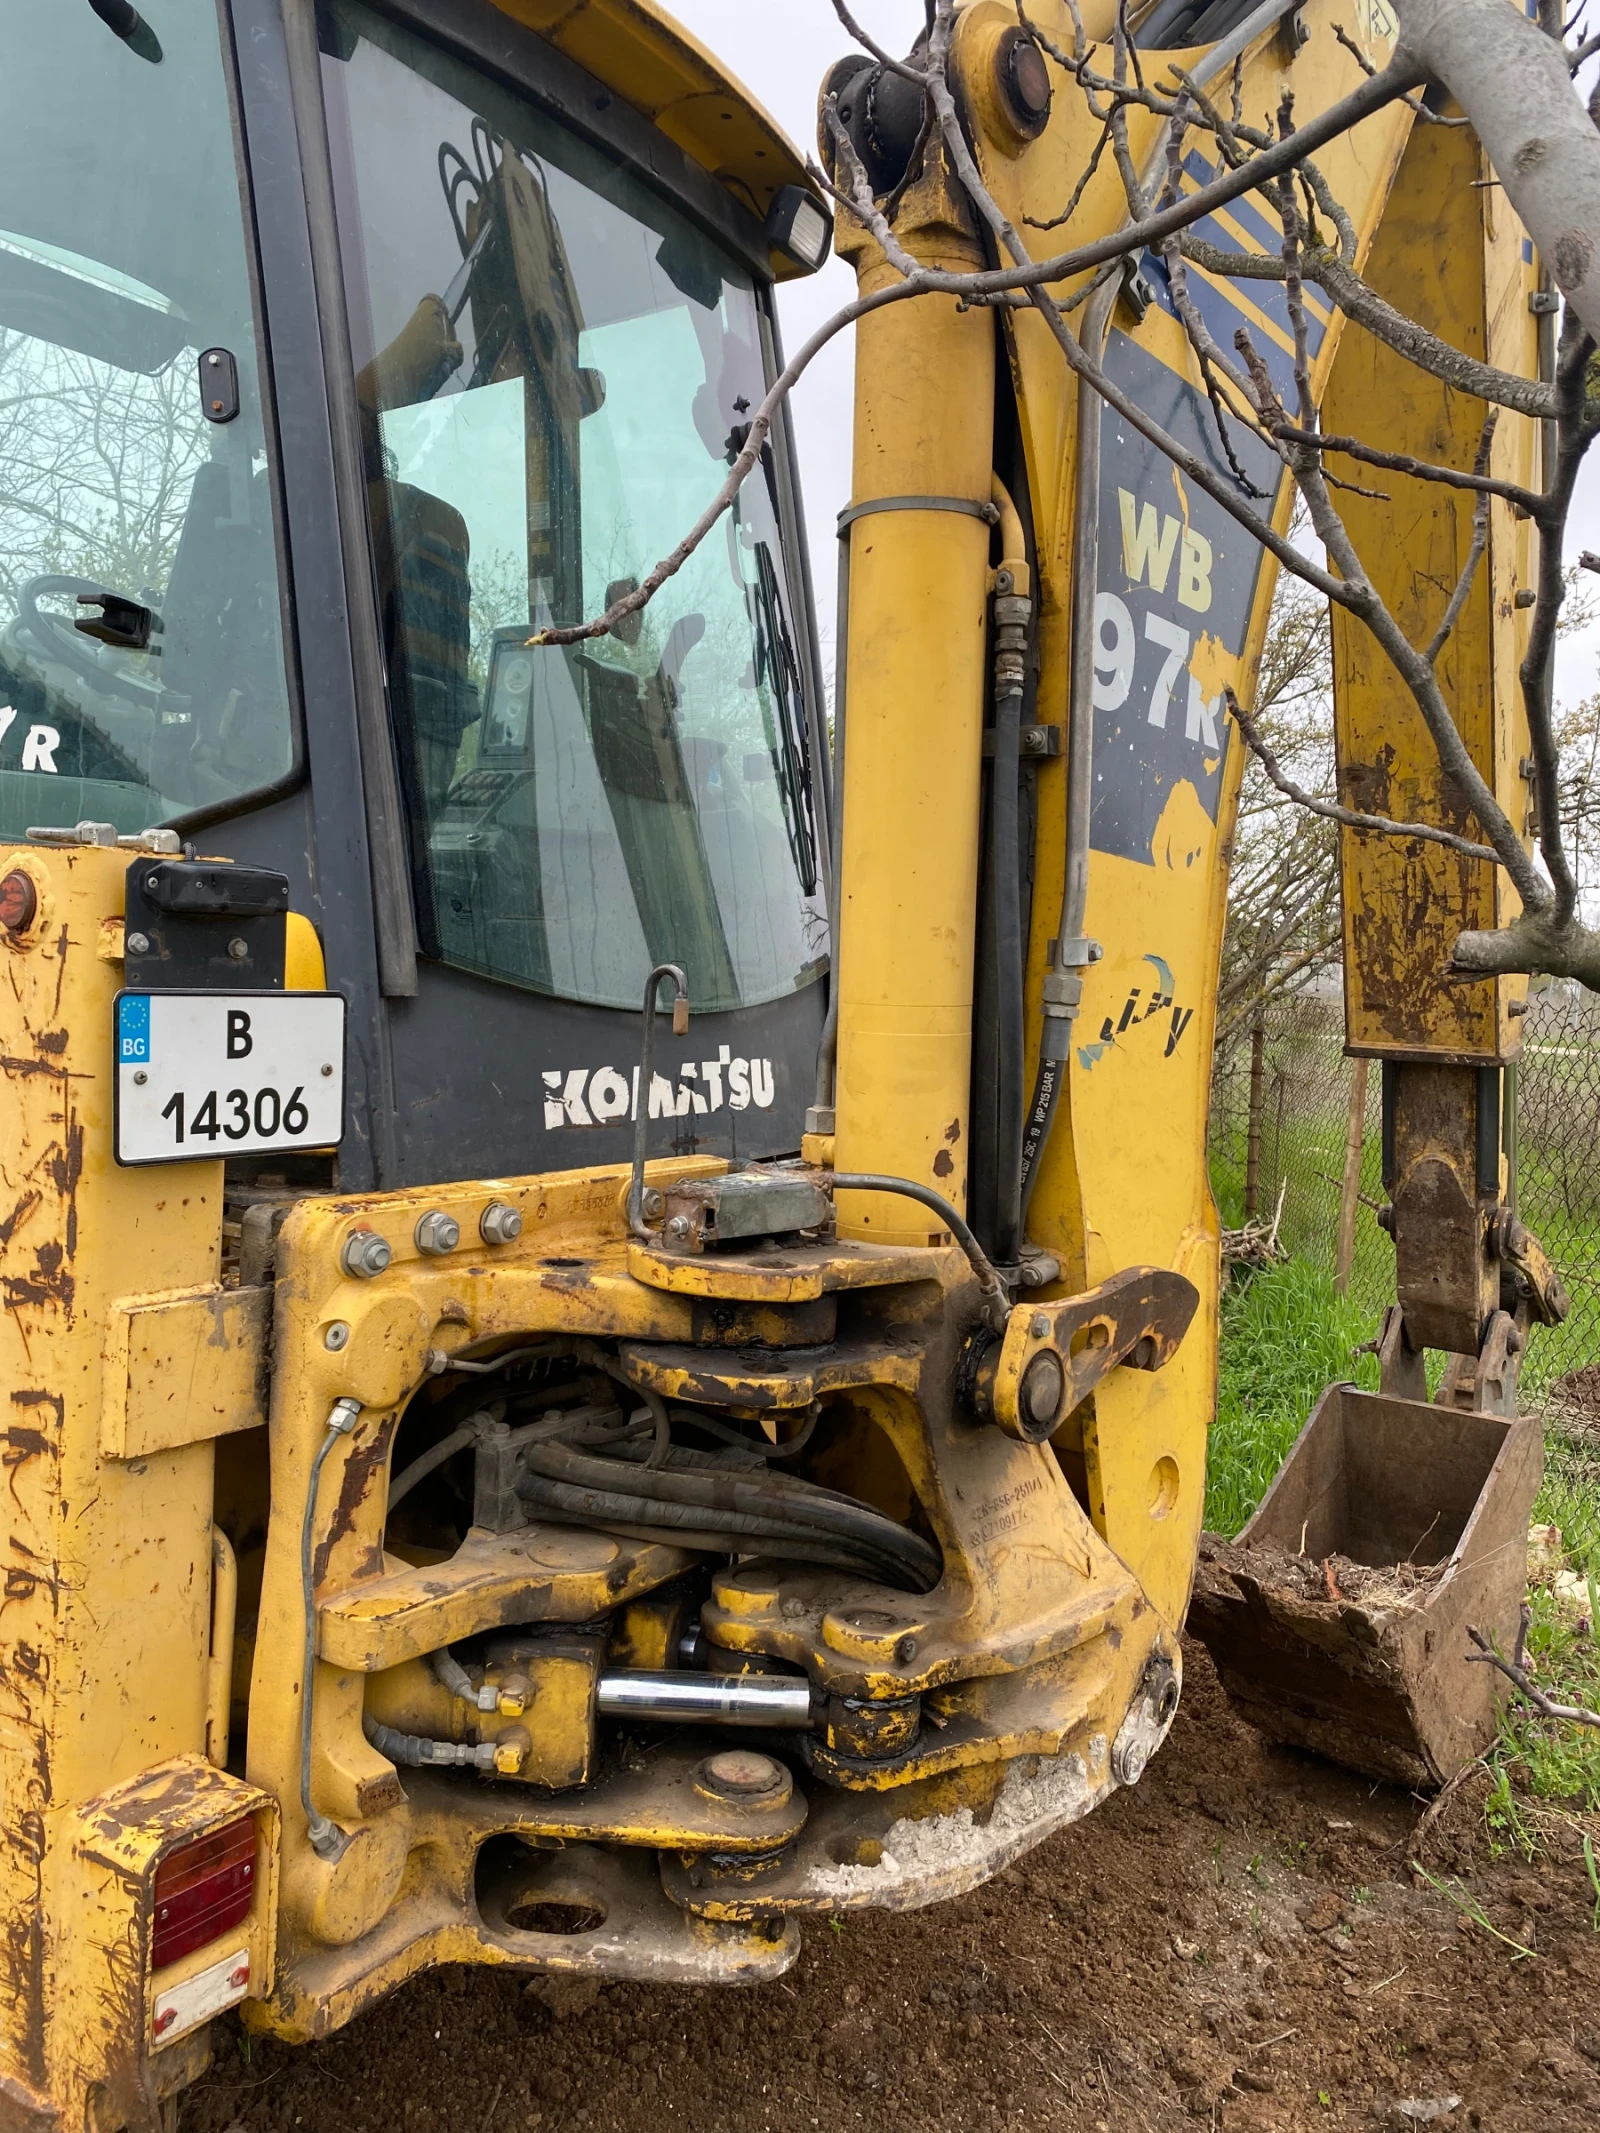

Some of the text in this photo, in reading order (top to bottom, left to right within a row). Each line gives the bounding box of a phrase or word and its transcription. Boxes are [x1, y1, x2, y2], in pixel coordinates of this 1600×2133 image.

[1118, 486, 1213, 614] WB
[226, 1009, 253, 1060] B
[122, 1037, 145, 1056] BG
[541, 1044, 775, 1130] KOMATSU
[1042, 1072, 1055, 1093] BAR
[1038, 1091, 1051, 1108] 215
[161, 1086, 309, 1144] 14306
[1034, 1107, 1047, 1123] WP
[1030, 1127, 1041, 1137] 19
[1024, 1140, 1037, 1158] 2SC
